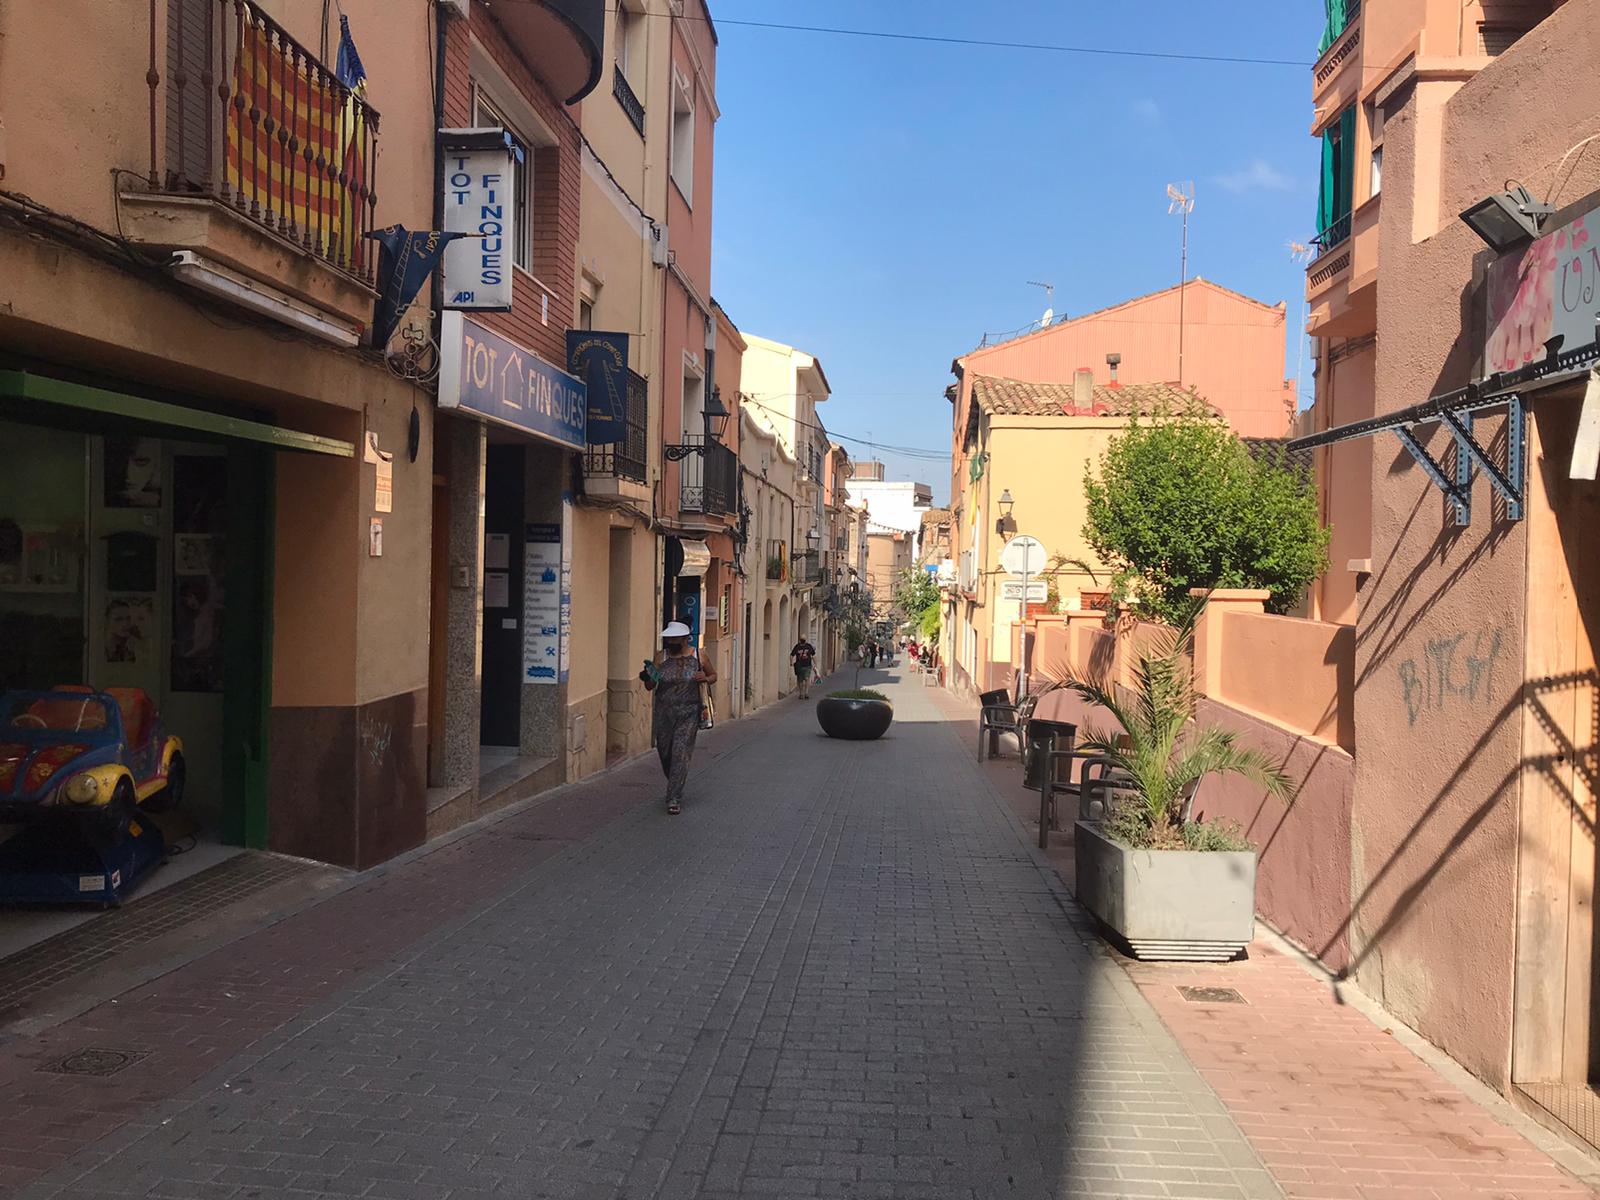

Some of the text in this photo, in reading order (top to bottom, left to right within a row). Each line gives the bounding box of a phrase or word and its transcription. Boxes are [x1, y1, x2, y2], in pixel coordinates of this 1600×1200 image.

[451, 157, 471, 205] TOT
[478, 174, 503, 285] FINQUES
[453, 292, 474, 303] API
[464, 336, 584, 431] TOT FINQUES
